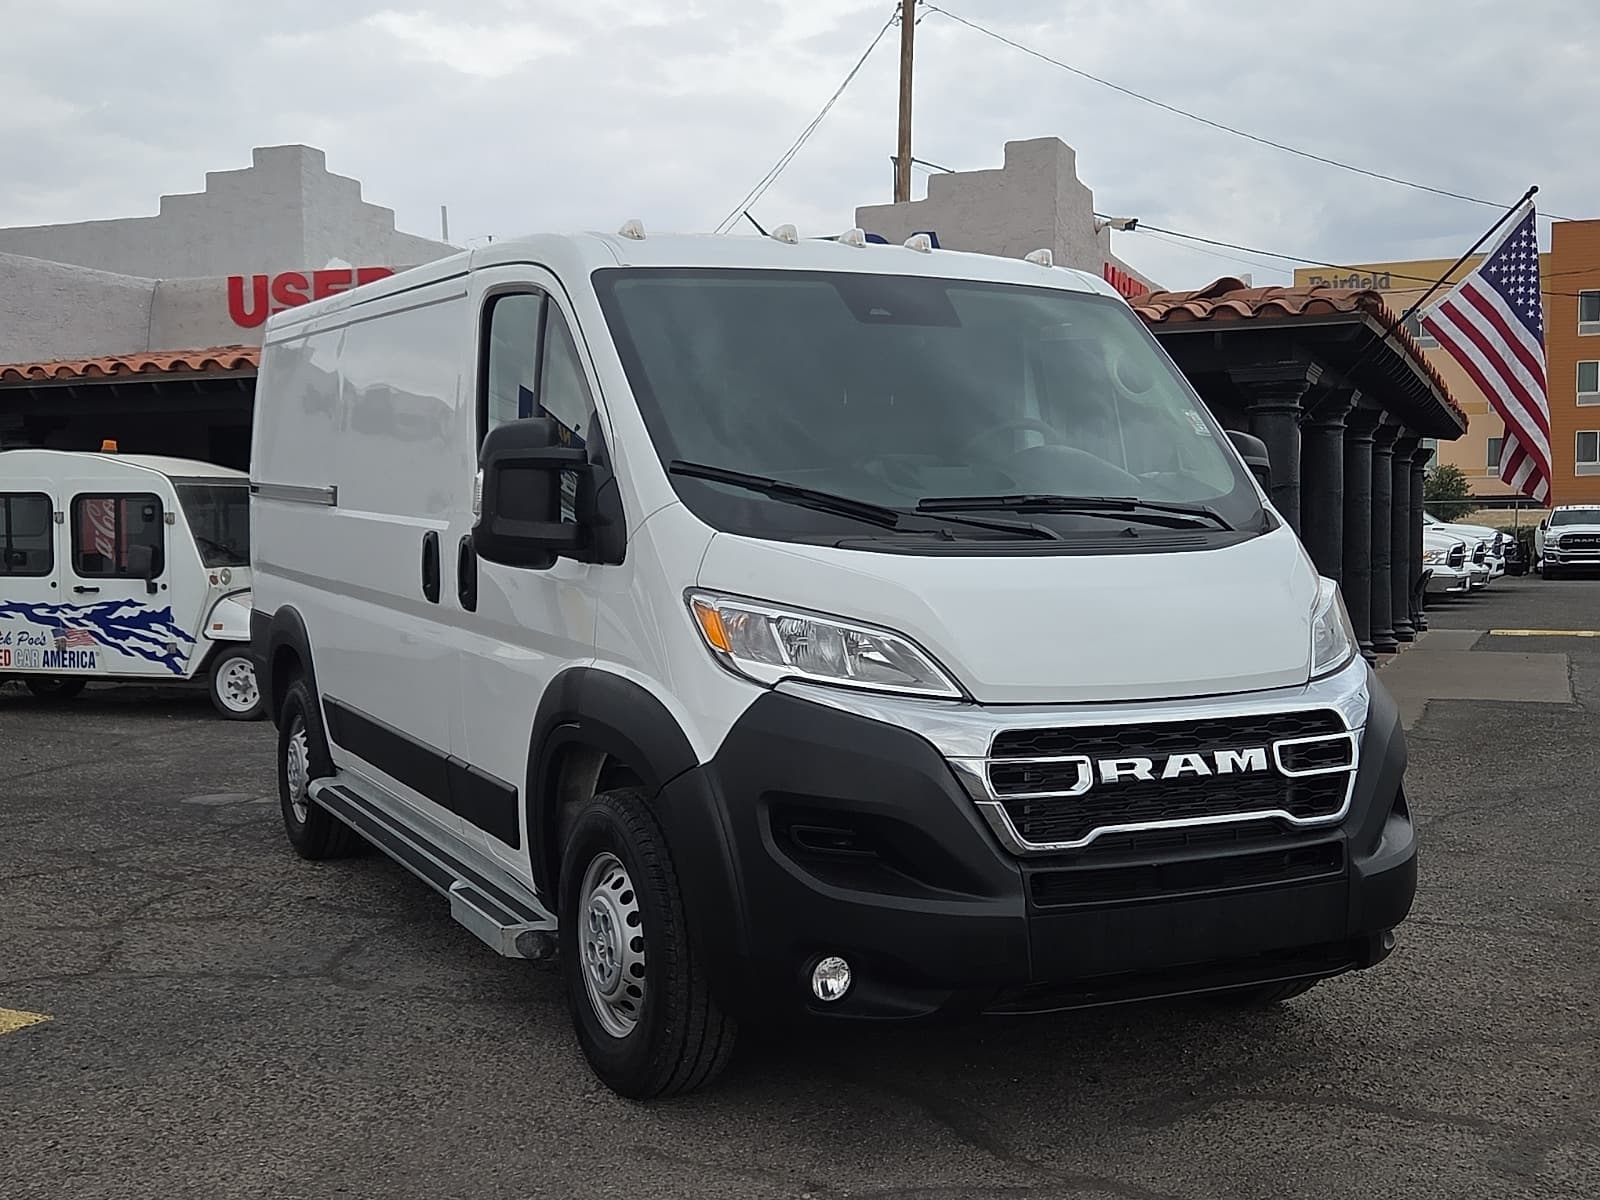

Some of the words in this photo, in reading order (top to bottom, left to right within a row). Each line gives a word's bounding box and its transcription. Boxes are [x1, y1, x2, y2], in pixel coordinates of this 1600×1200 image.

[227, 267, 396, 328] USE
[14, 649, 40, 668] CAR
[42, 650, 96, 669] AMERICA
[1098, 747, 1268, 784] RAM
